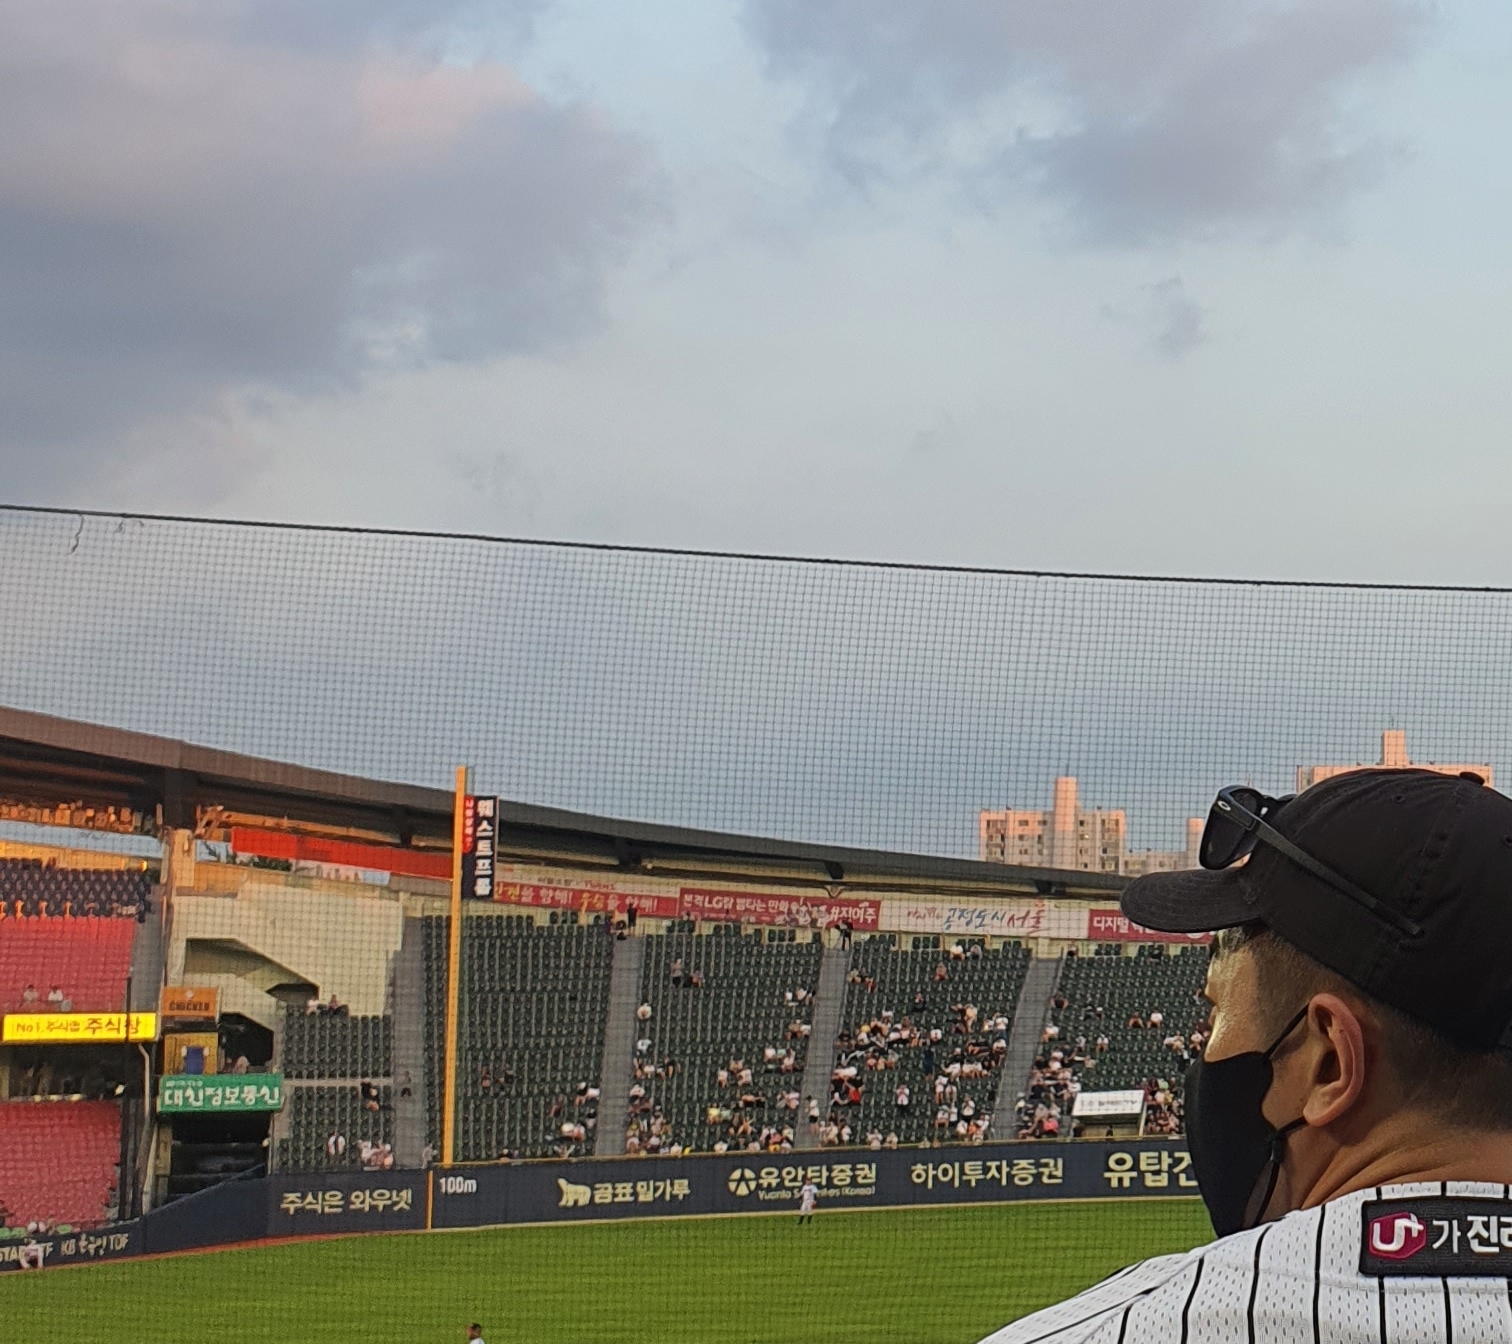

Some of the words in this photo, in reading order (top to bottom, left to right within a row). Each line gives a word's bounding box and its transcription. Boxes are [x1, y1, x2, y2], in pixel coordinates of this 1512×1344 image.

[1093, 915, 1128, 934] 디지털
[758, 1162, 877, 1188] 유안타증권
[910, 1158, 1064, 1187] 하이투자증권
[440, 1177, 477, 1195] 100m
[280, 1191, 344, 1215] 주식은
[349, 1188, 412, 1213] 와우넷
